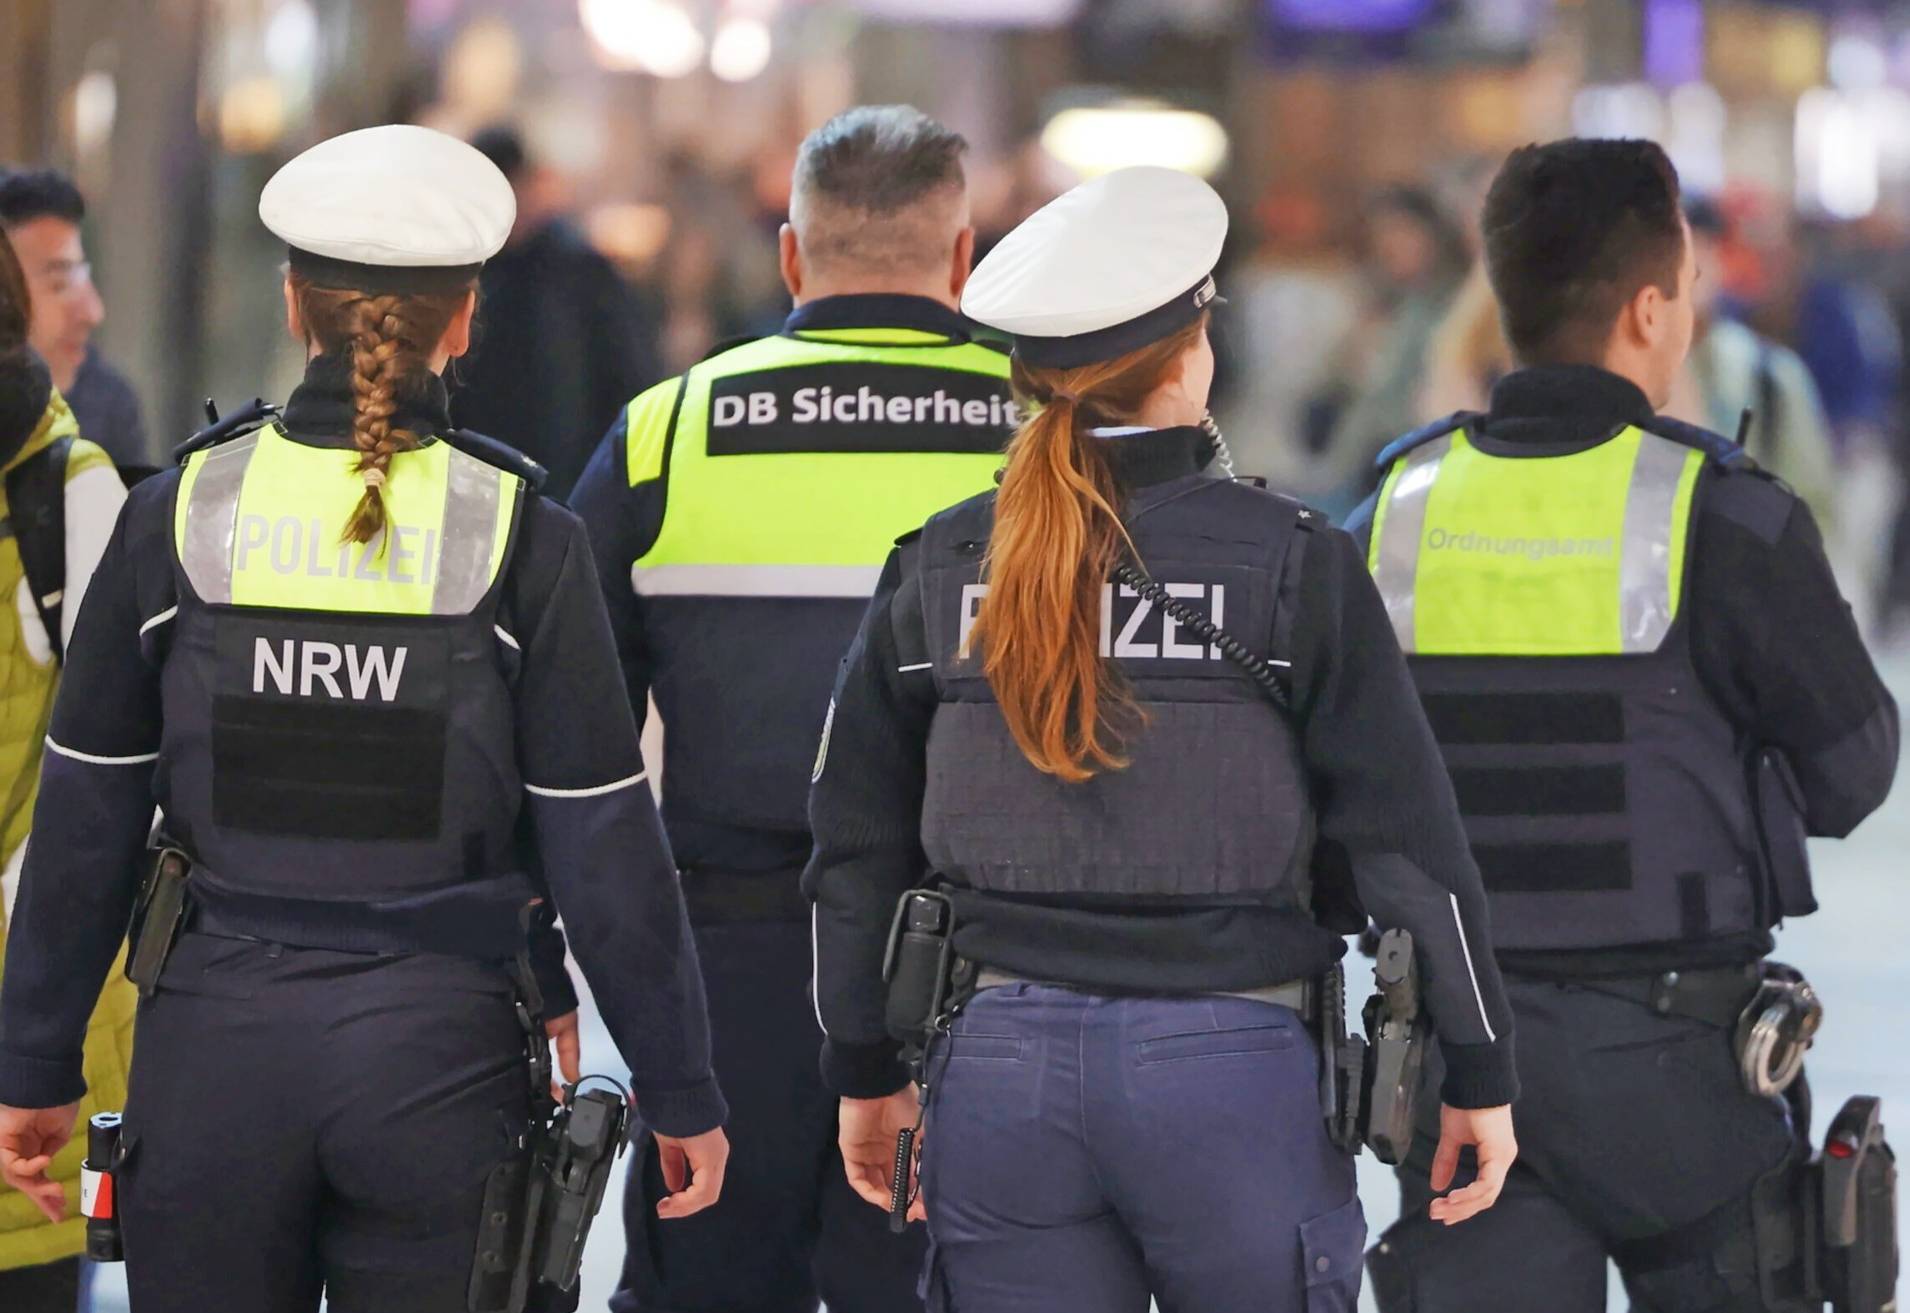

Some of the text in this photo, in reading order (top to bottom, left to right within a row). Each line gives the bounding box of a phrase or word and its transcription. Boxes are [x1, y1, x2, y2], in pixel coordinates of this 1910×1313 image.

[713, 385, 1021, 427] DB Sicherheit
[1428, 527, 1614, 561] Ordnungsamt
[959, 583, 1224, 660] PIZEI
[253, 637, 408, 702] NRW
